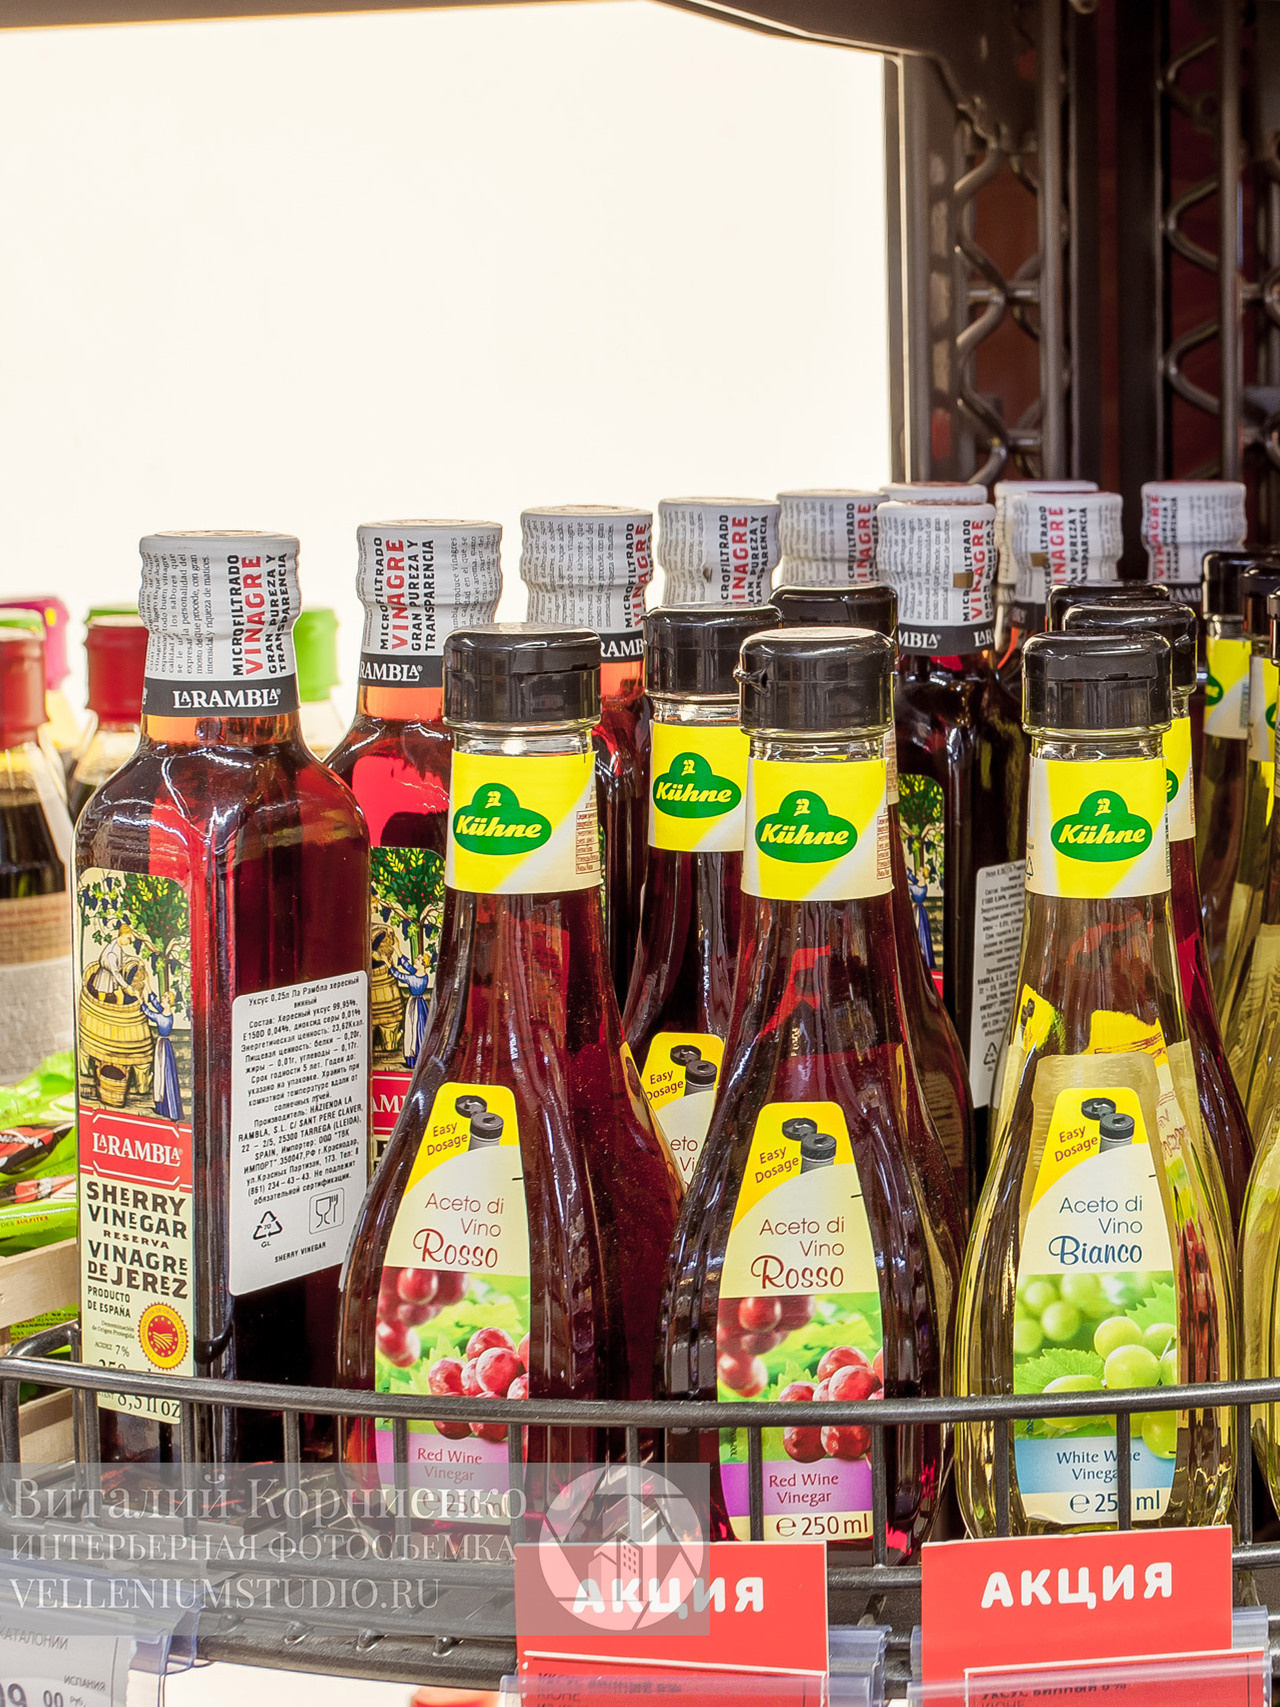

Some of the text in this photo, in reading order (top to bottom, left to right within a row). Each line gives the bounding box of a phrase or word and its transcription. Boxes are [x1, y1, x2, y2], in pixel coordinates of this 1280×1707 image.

[373, 537, 389, 650] MICROFILTRADO
[386, 539, 408, 649] VINAGRE
[422, 540, 435, 651] TRANSPARENCIA
[228, 554, 244, 676] MICROFILTRADO
[242, 555, 265, 674] VINAGRE
[276, 552, 287, 672] TRANSPARENCIA
[655, 782, 732, 803] Kühne
[454, 814, 542, 839] Kühne
[760, 822, 849, 846] Kühne
[1058, 823, 1147, 845] Kühne
[249, 996, 268, 1006] Уксус
[271, 993, 289, 1002] 0,25л
[303, 984, 327, 995] Рамбла
[649, 1069, 674, 1085] Easy
[432, 1122, 458, 1138] Easy
[1059, 1126, 1086, 1143] Easy
[427, 1132, 468, 1157] Dosage
[759, 1146, 787, 1165] Easy
[1054, 1136, 1098, 1162] Dosage
[754, 1156, 799, 1184] Dosage
[87, 1181, 186, 1217] SHERRY
[425, 1193, 504, 1215] Aceto di
[1059, 1195, 1143, 1214] Aceto di
[16, 1215, 49, 1226] SULFITES
[87, 1204, 187, 1239] VINEGAR
[460, 1218, 502, 1237] Vino
[759, 1216, 845, 1236] Aceto di
[1099, 1217, 1143, 1234] Vino
[103, 1230, 169, 1249] RESERVA
[413, 1228, 498, 1268] Rosso
[800, 1240, 845, 1257] Vino
[1048, 1235, 1143, 1266] Bianco
[88, 1240, 188, 1276] VINAGRE
[110, 1266, 188, 1299] JEREZ
[750, 1255, 844, 1290] Rosso
[88, 1286, 130, 1303] PRODUCTO
[88, 1300, 131, 1318] DE ESPAÑA
[418, 1448, 482, 1465] Red Wine
[1056, 1451, 1099, 1464] White
[424, 1466, 475, 1484] Vinegar
[769, 1473, 838, 1488] Red Wine
[776, 1492, 832, 1507] Vinegar
[1136, 1490, 1160, 1510] ml
[801, 1513, 867, 1536] 250 ml
[980, 1561, 1174, 1608] АКЦИЯ
[574, 1576, 765, 1620] АКЦИЯ
[64, 1674, 106, 1692] ИСПАНИЯ
